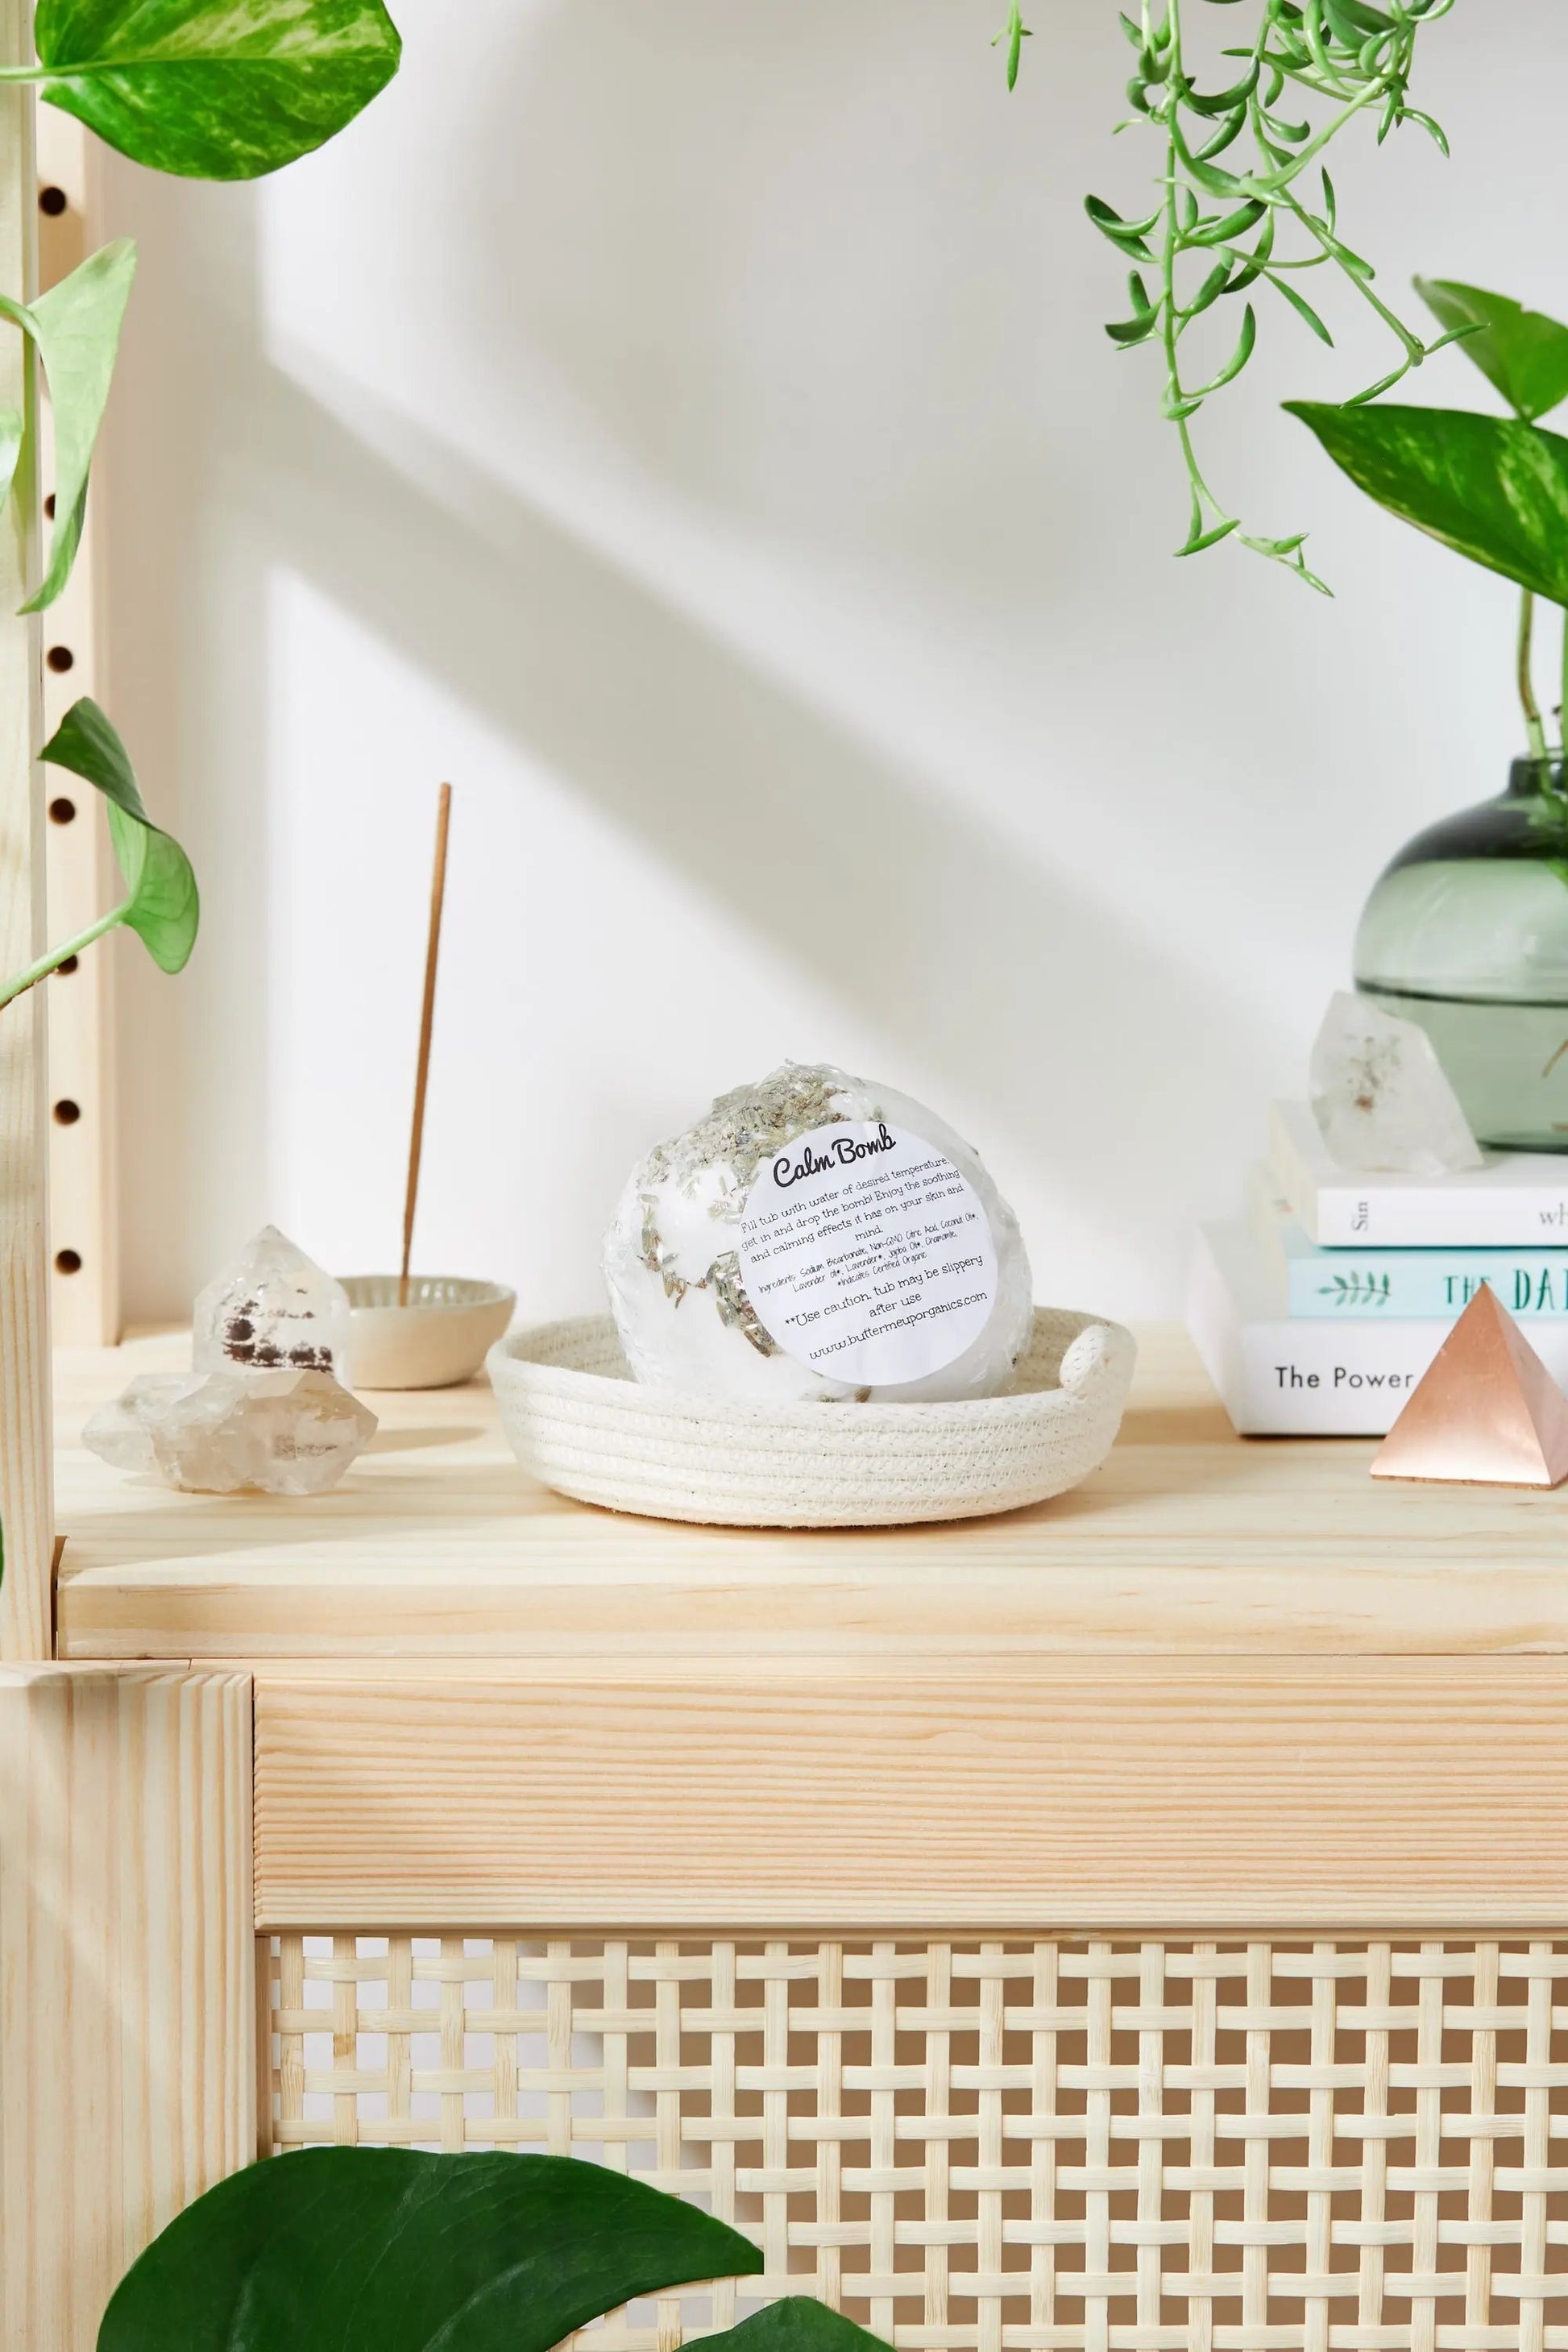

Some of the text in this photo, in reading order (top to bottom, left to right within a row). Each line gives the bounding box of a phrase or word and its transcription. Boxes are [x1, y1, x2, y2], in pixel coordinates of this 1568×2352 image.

[773, 1123, 897, 1188] Calm Bomb
[740, 1221, 757, 1233] Fill
[759, 1213, 778, 1226] tub
[781, 1202, 807, 1217] with
[809, 1191, 839, 1207] water
[842, 1184, 853, 1196] of
[856, 1172, 890, 1191] desired
[741, 1169, 960, 1252] get in and drop the bomb! Enjoy the soothing
[750, 1182, 964, 1263] and calming effects it has on your skin and
[940, 1214, 964, 1230] Coconut
[1352, 1201, 1369, 1232] Sin
[855, 1224, 884, 1242] mind.
[792, 1274, 827, 1293] Lavender
[888, 1245, 909, 1259] Jojoba
[873, 1259, 901, 1276] Certified
[902, 1251, 928, 1265] Organic
[873, 1282, 896, 1296] tub
[898, 1273, 924, 1288] may
[924, 1267, 940, 1280] be
[941, 1255, 984, 1275] slippery
[809, 1292, 988, 1359] www.buttermeuporganics.com
[869, 1292, 923, 1318] after use
[1275, 1365, 1414, 1388] The Power
